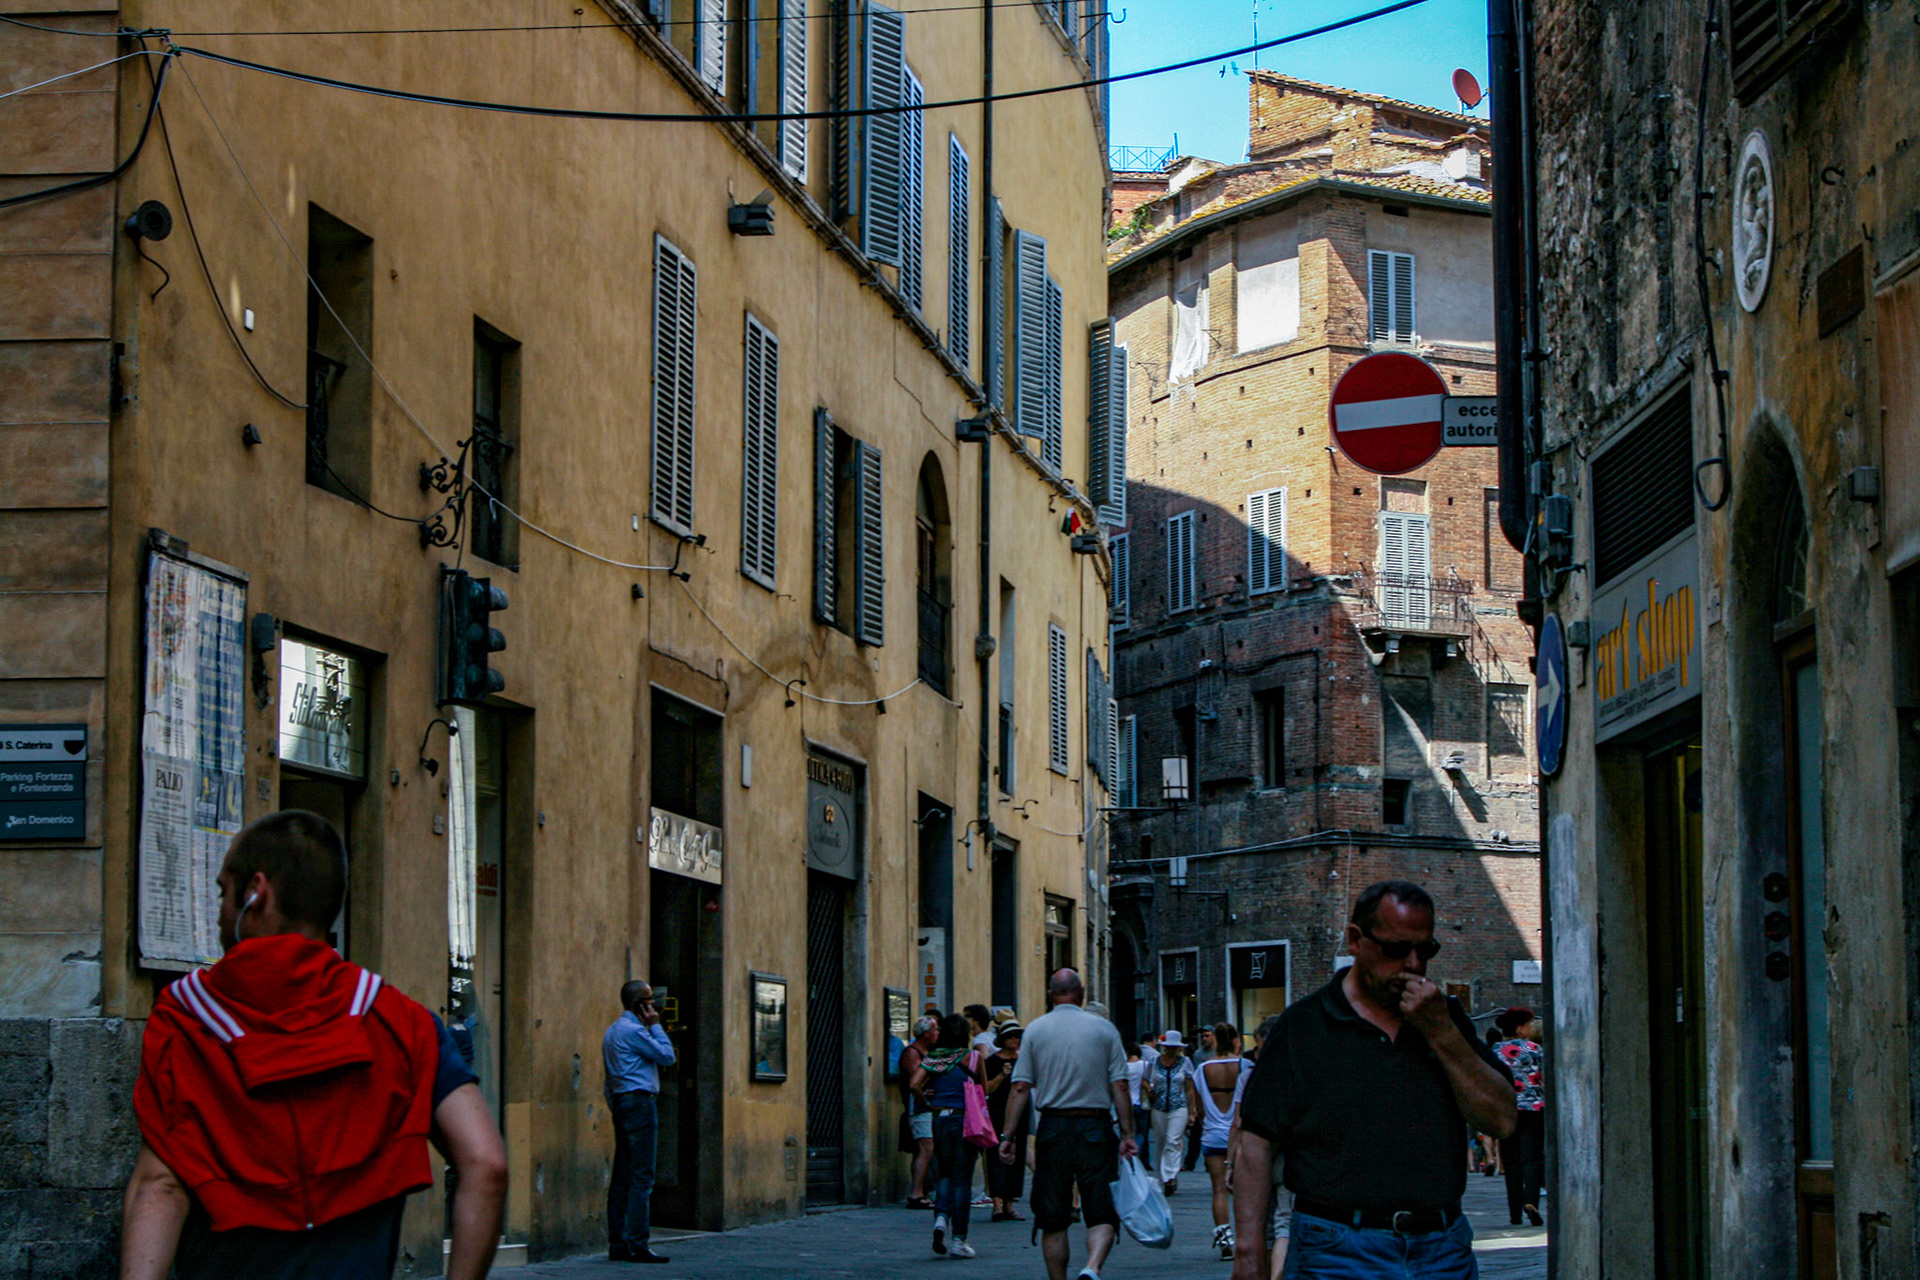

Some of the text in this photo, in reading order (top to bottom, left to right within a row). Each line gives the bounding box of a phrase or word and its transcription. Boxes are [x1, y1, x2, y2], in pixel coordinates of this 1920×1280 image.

[1597, 577, 1695, 701] art shop
[16, 741, 53, 750] Caterina
[0, 772, 74, 783] Parking Fortezza
[155, 768, 184, 792] PALIO
[19, 783, 74, 793] Fontebranda
[29, 815, 74, 824] Domenico
